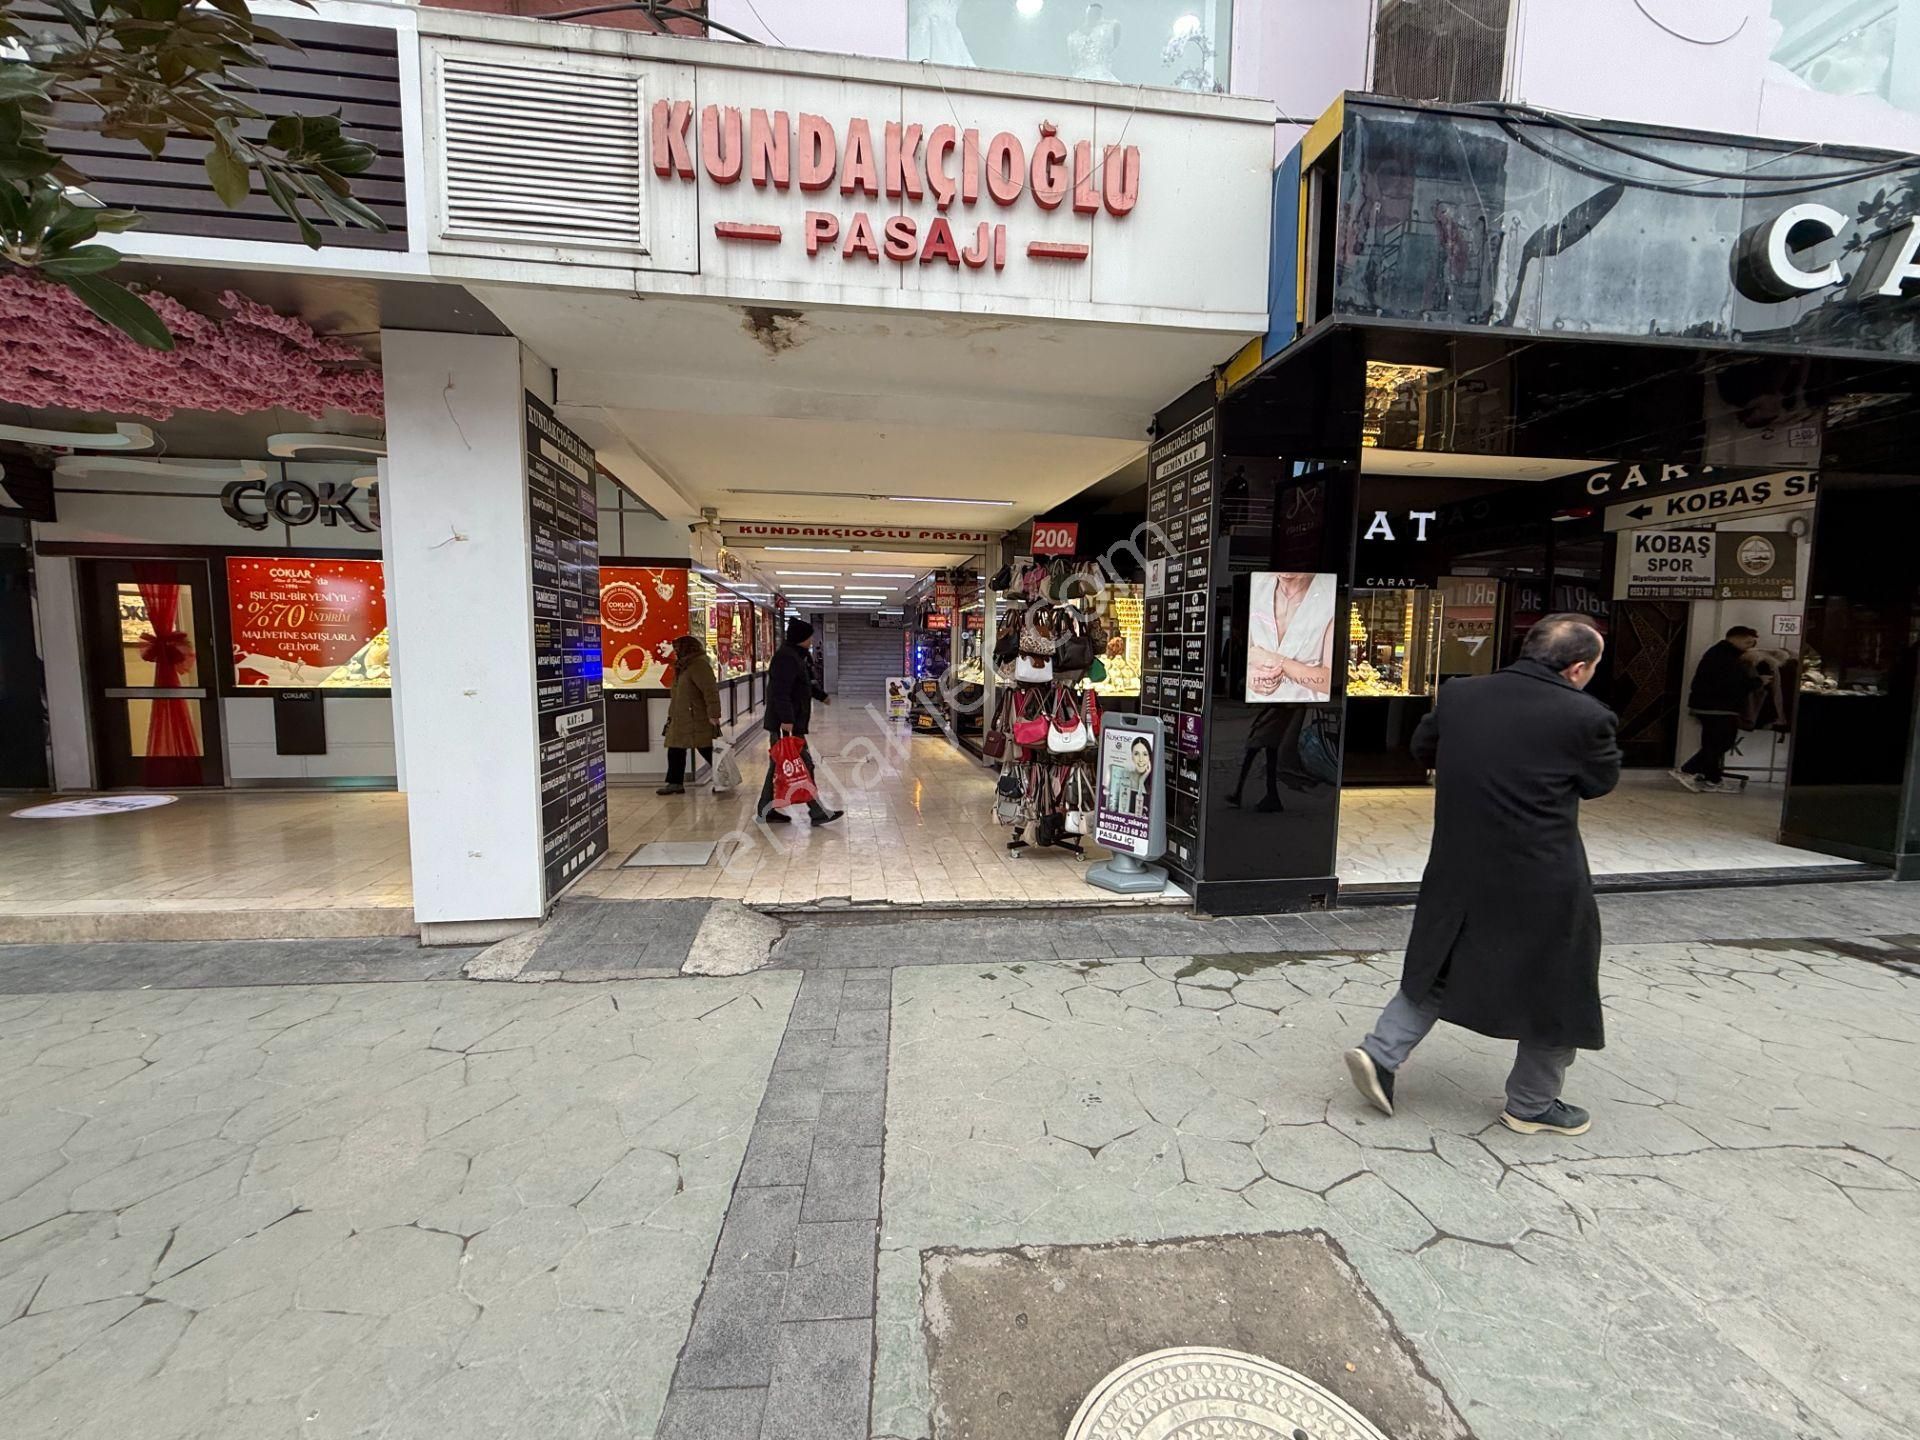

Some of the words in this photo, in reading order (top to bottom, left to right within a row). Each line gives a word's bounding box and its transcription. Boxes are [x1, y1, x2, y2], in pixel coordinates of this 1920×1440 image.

[651, 99, 1140, 217] KUNDAKÇIOĞLU
[804, 211, 1007, 271] PASAJI
[1666, 481, 1772, 516] KOBAŞ
[739, 525, 911, 539] KUNDAKÇIOĞLU
[918, 530, 989, 542] PASAJI
[1635, 535, 1711, 559] KOBAŞ
[1647, 558, 1693, 573] SPOR
[1366, 577, 1416, 587] CARAT
[245, 600, 306, 628] %70
[242, 630, 300, 641] MALİYETİNE
[301, 632, 357, 643] SATIŞLARLA
